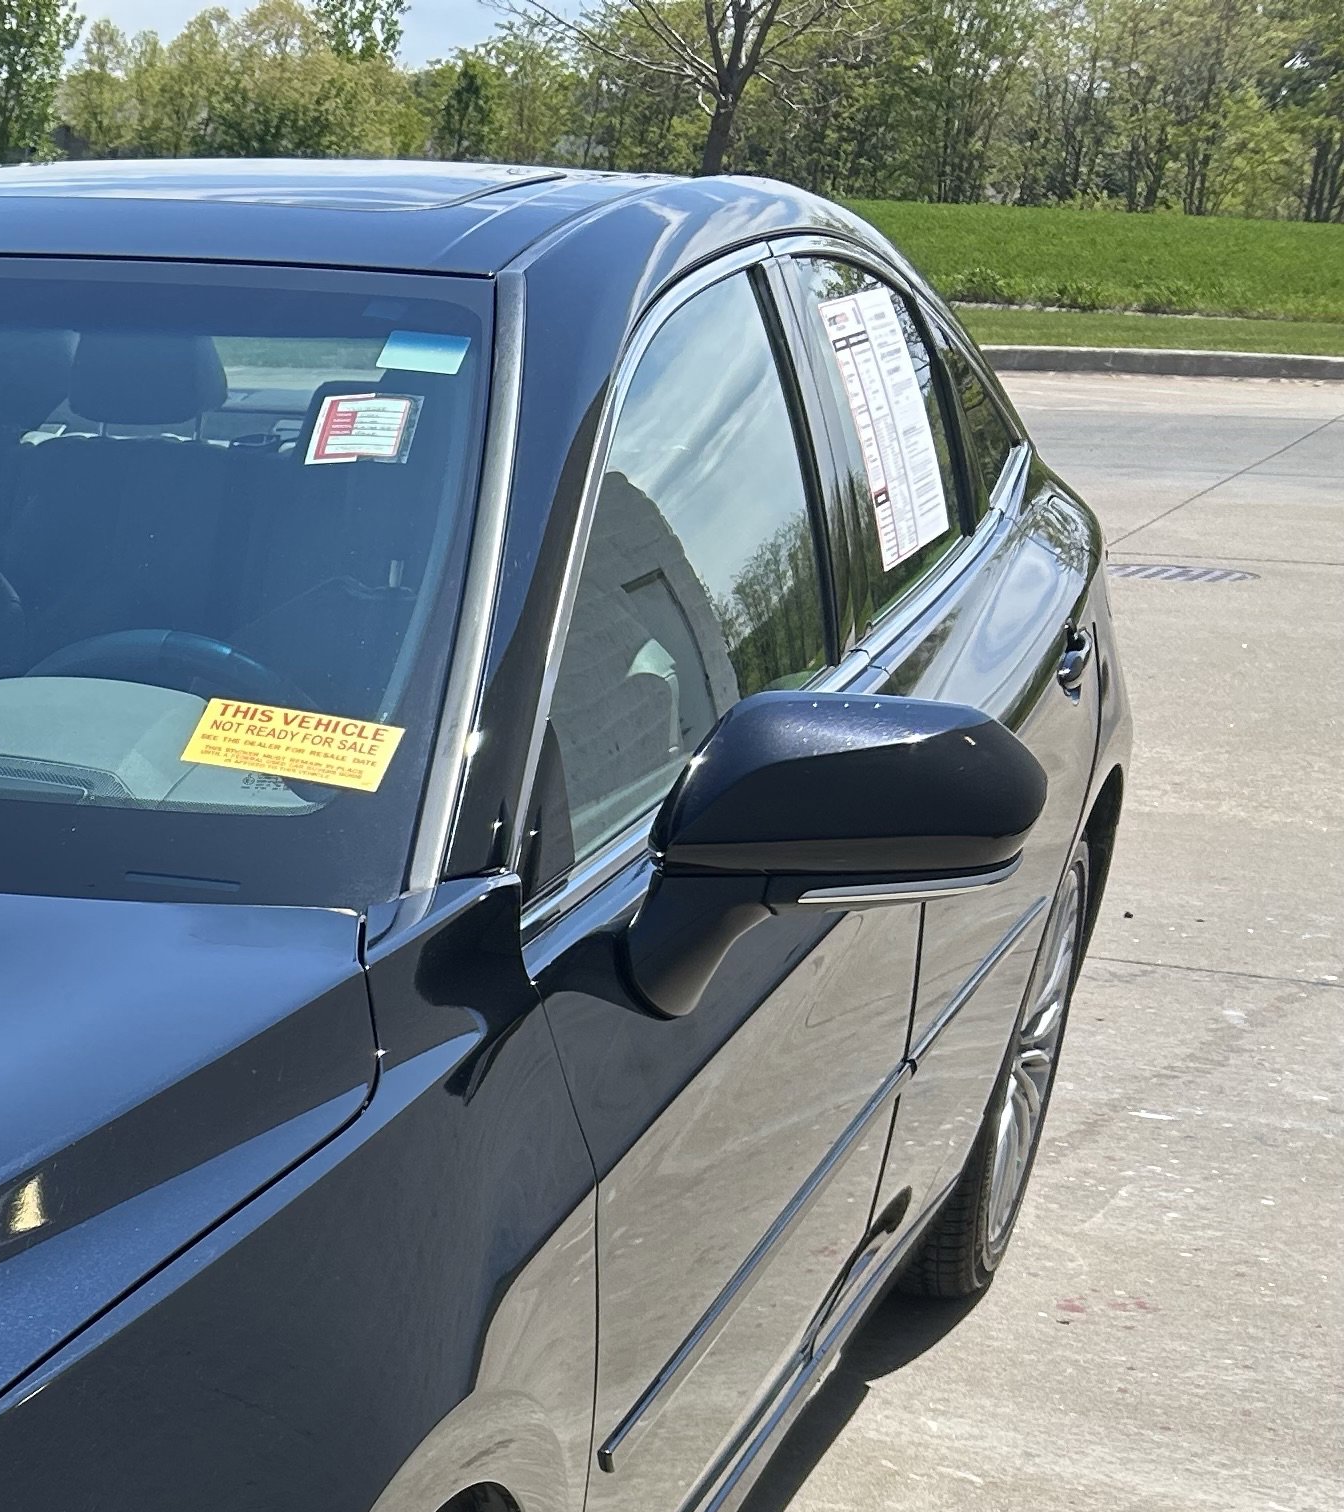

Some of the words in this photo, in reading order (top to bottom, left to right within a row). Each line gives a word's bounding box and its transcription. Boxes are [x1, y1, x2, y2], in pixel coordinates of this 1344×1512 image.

[210, 719, 244, 733] NOT
[245, 724, 300, 742] READY
[301, 733, 334, 748] FOR
[337, 739, 379, 756] SALE
[220, 703, 274, 723] THIS
[283, 712, 389, 743] VEHICLE
